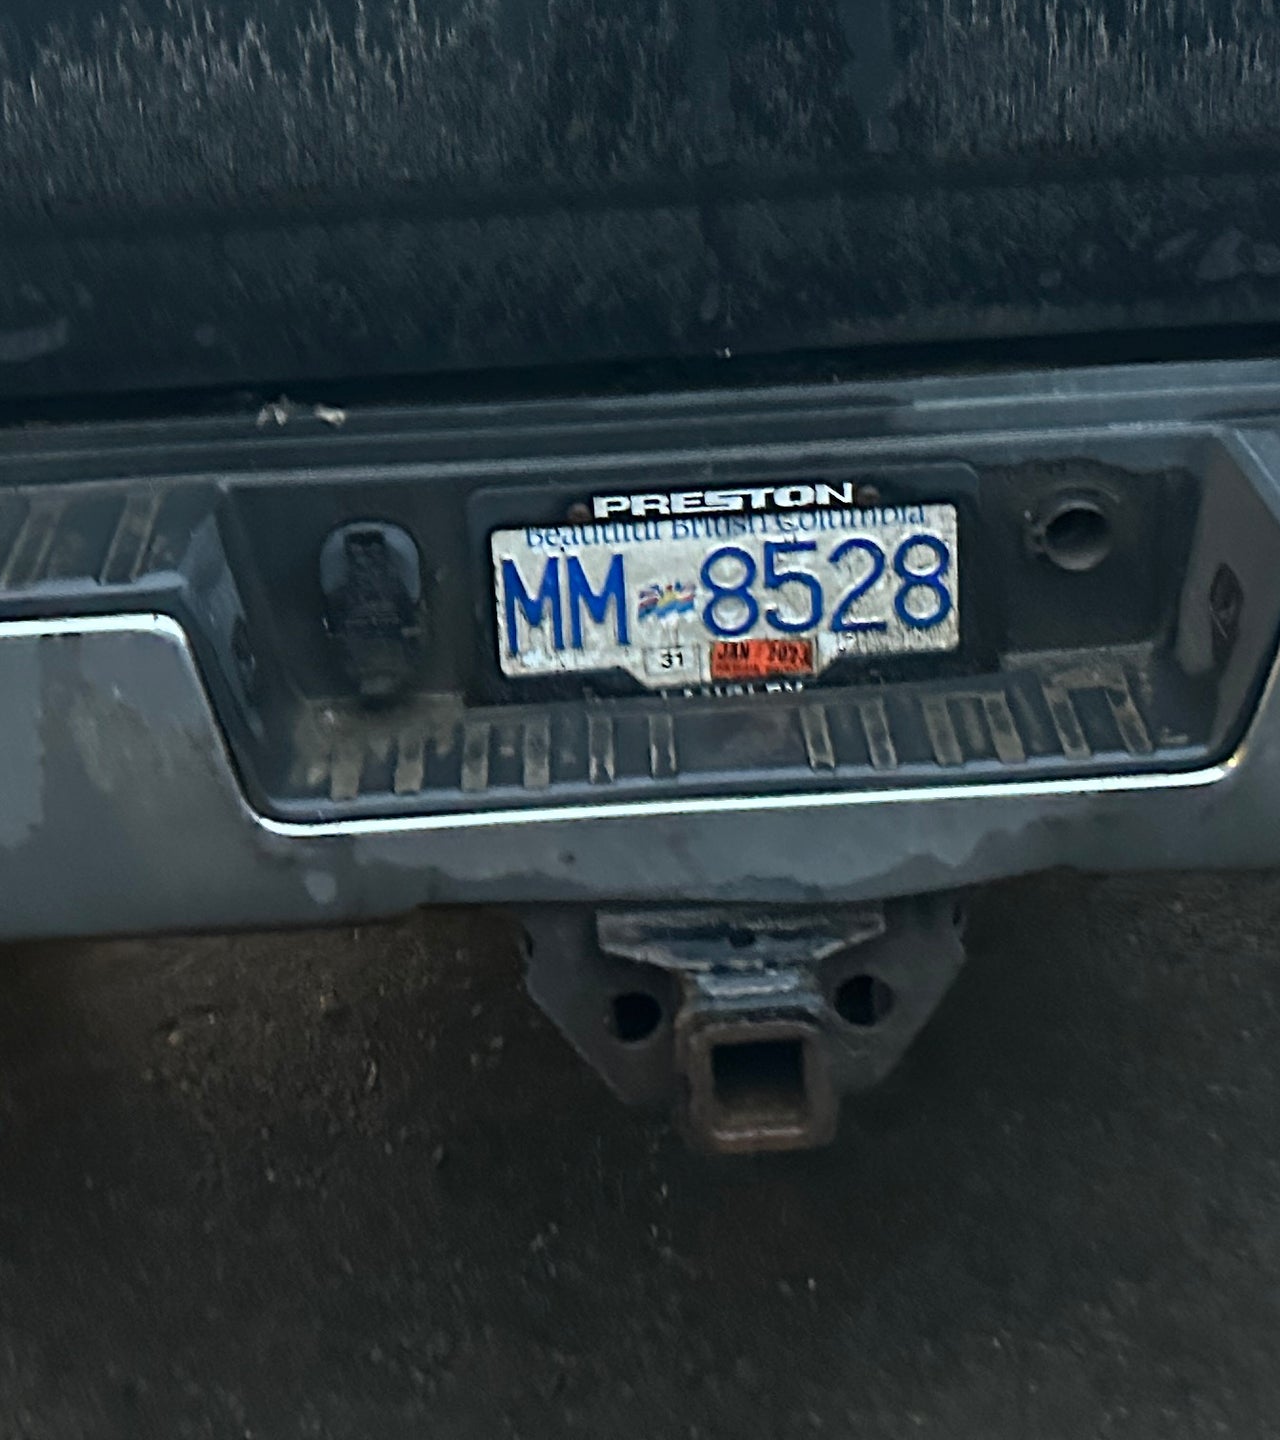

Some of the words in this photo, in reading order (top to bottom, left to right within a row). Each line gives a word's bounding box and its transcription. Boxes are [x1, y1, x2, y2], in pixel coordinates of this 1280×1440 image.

[593, 482, 853, 519] PRESTON
[502, 553, 631, 656] MM
[700, 534, 952, 637] 8528
[660, 650, 684, 669] 31
